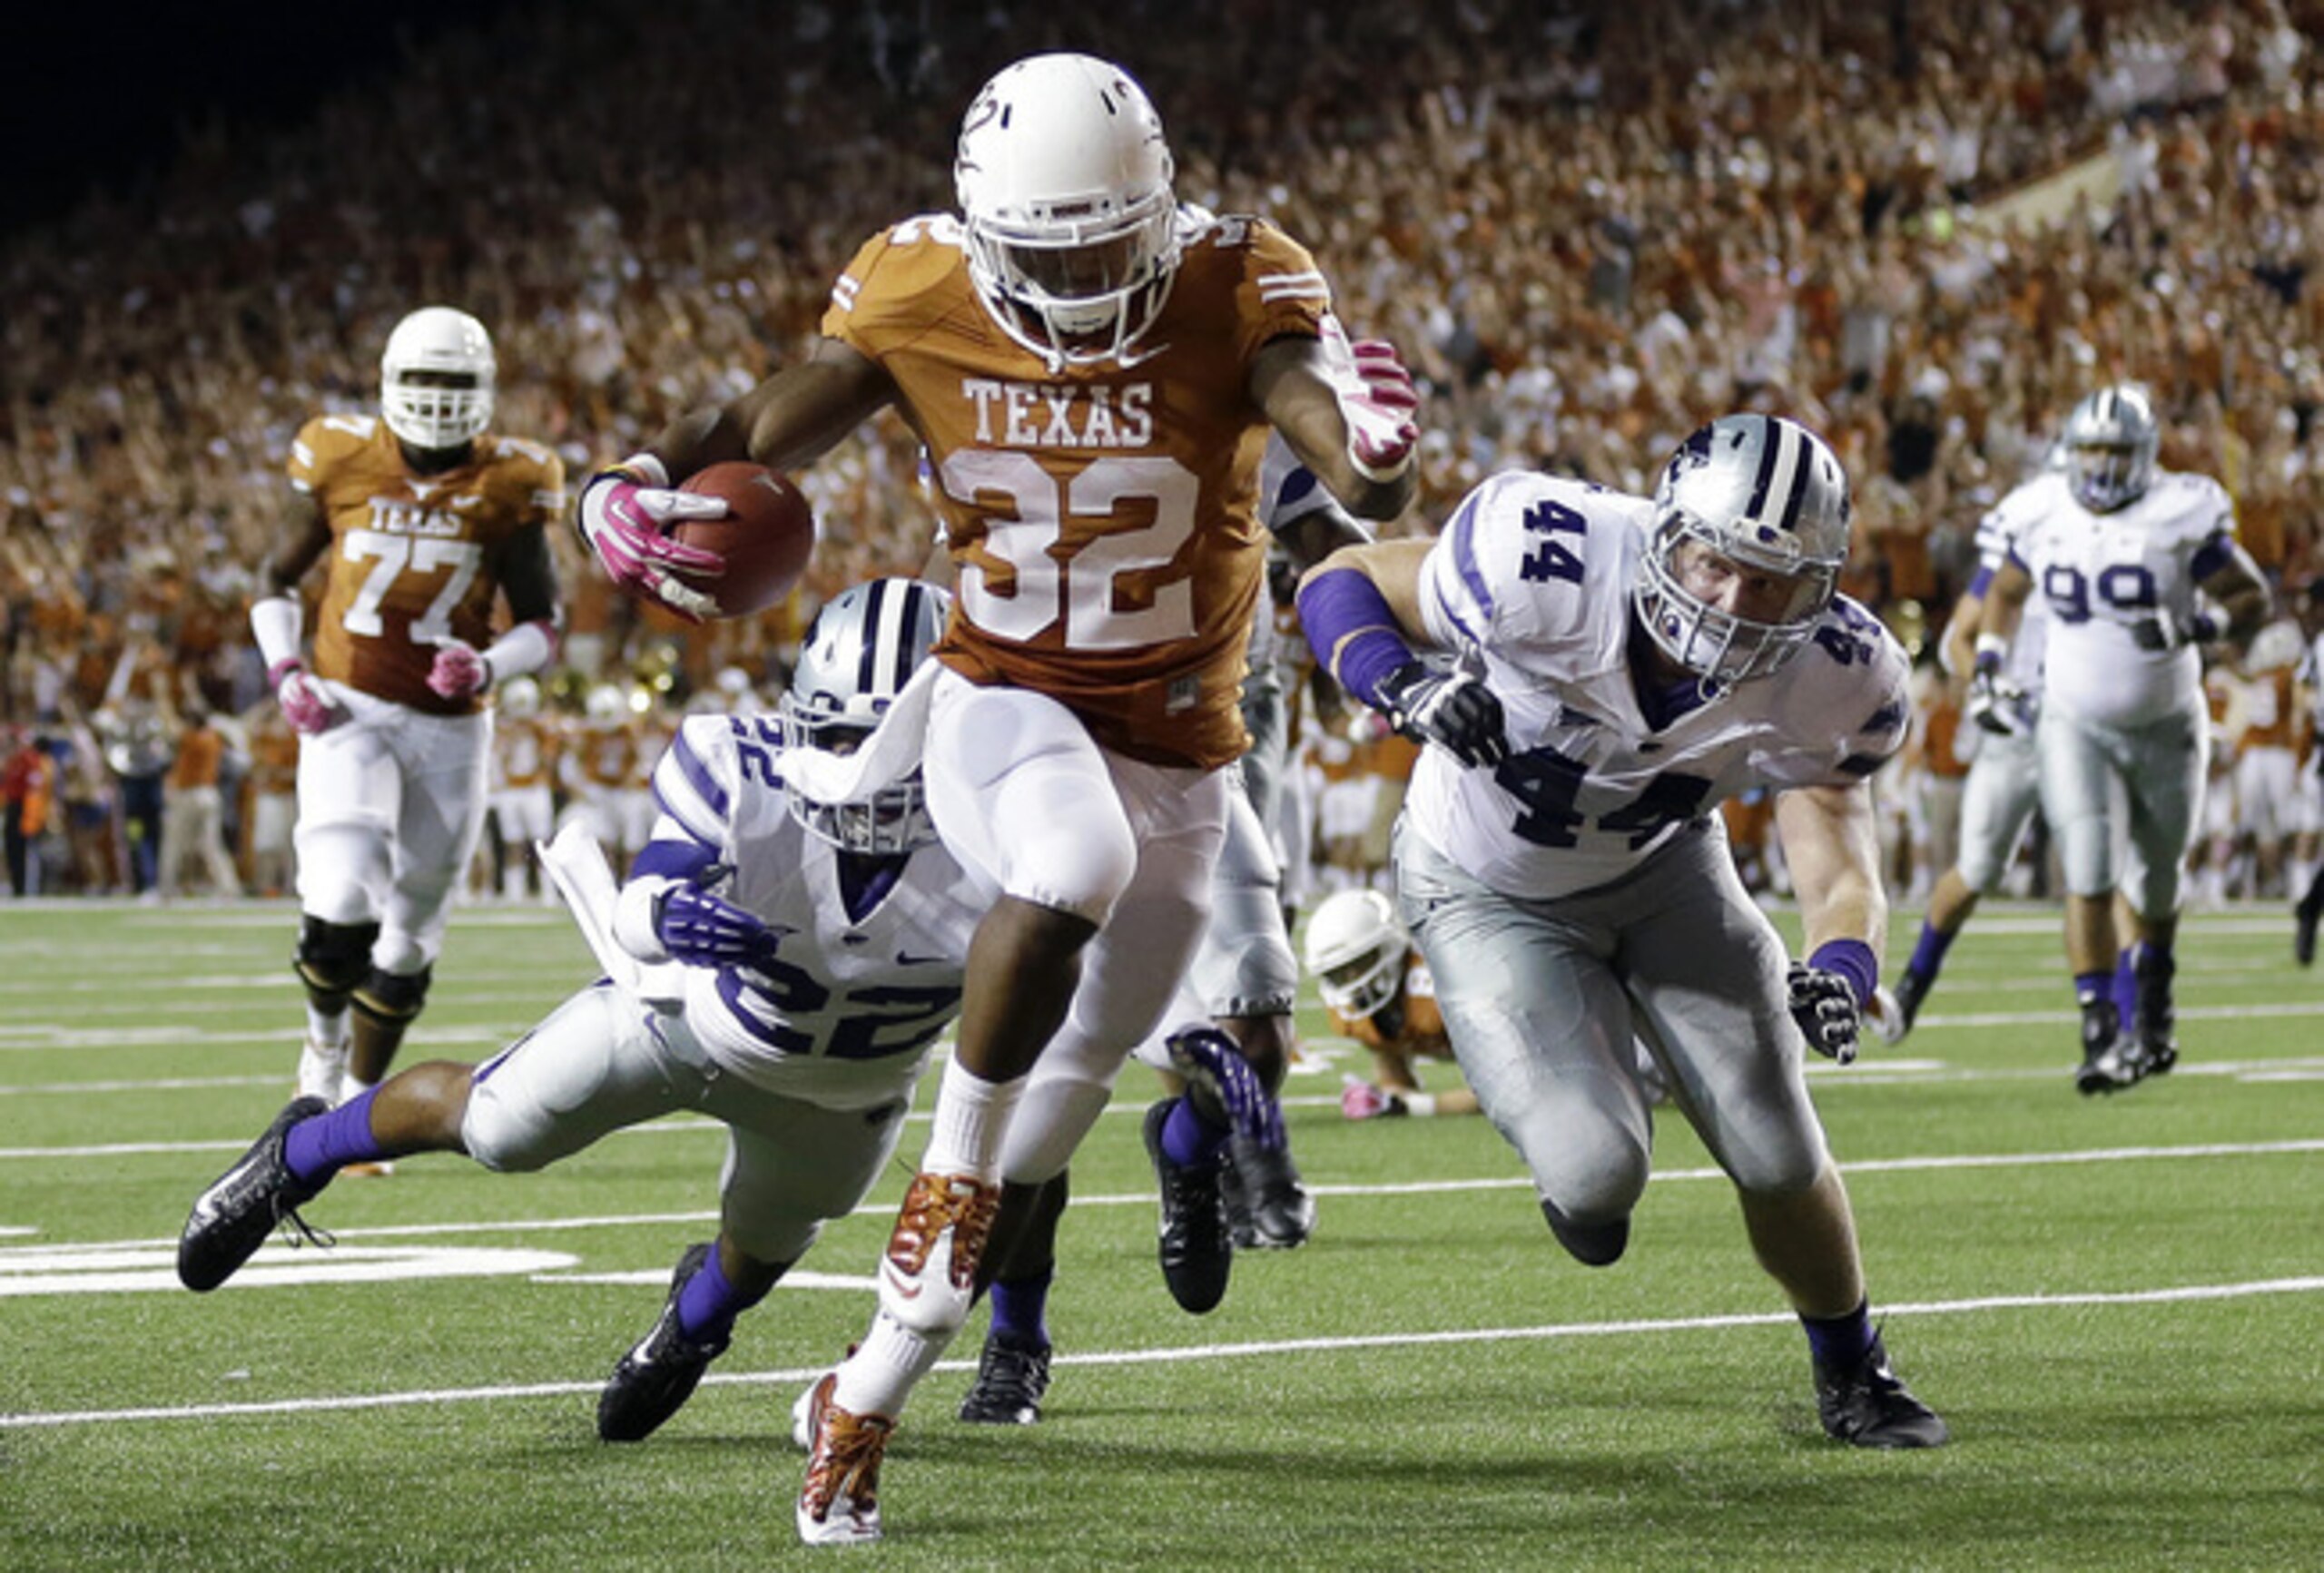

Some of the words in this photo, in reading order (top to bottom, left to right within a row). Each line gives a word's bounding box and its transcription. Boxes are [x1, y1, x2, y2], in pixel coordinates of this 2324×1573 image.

[962, 378, 1153, 447] TEXAS
[368, 496, 462, 536] TEXAS
[941, 447, 1200, 649] 32
[1519, 499, 1588, 586] 44
[342, 528, 484, 644] 77
[2043, 564, 2157, 624] 99
[1493, 743, 1714, 851] 44
[715, 953, 962, 1060] 22
